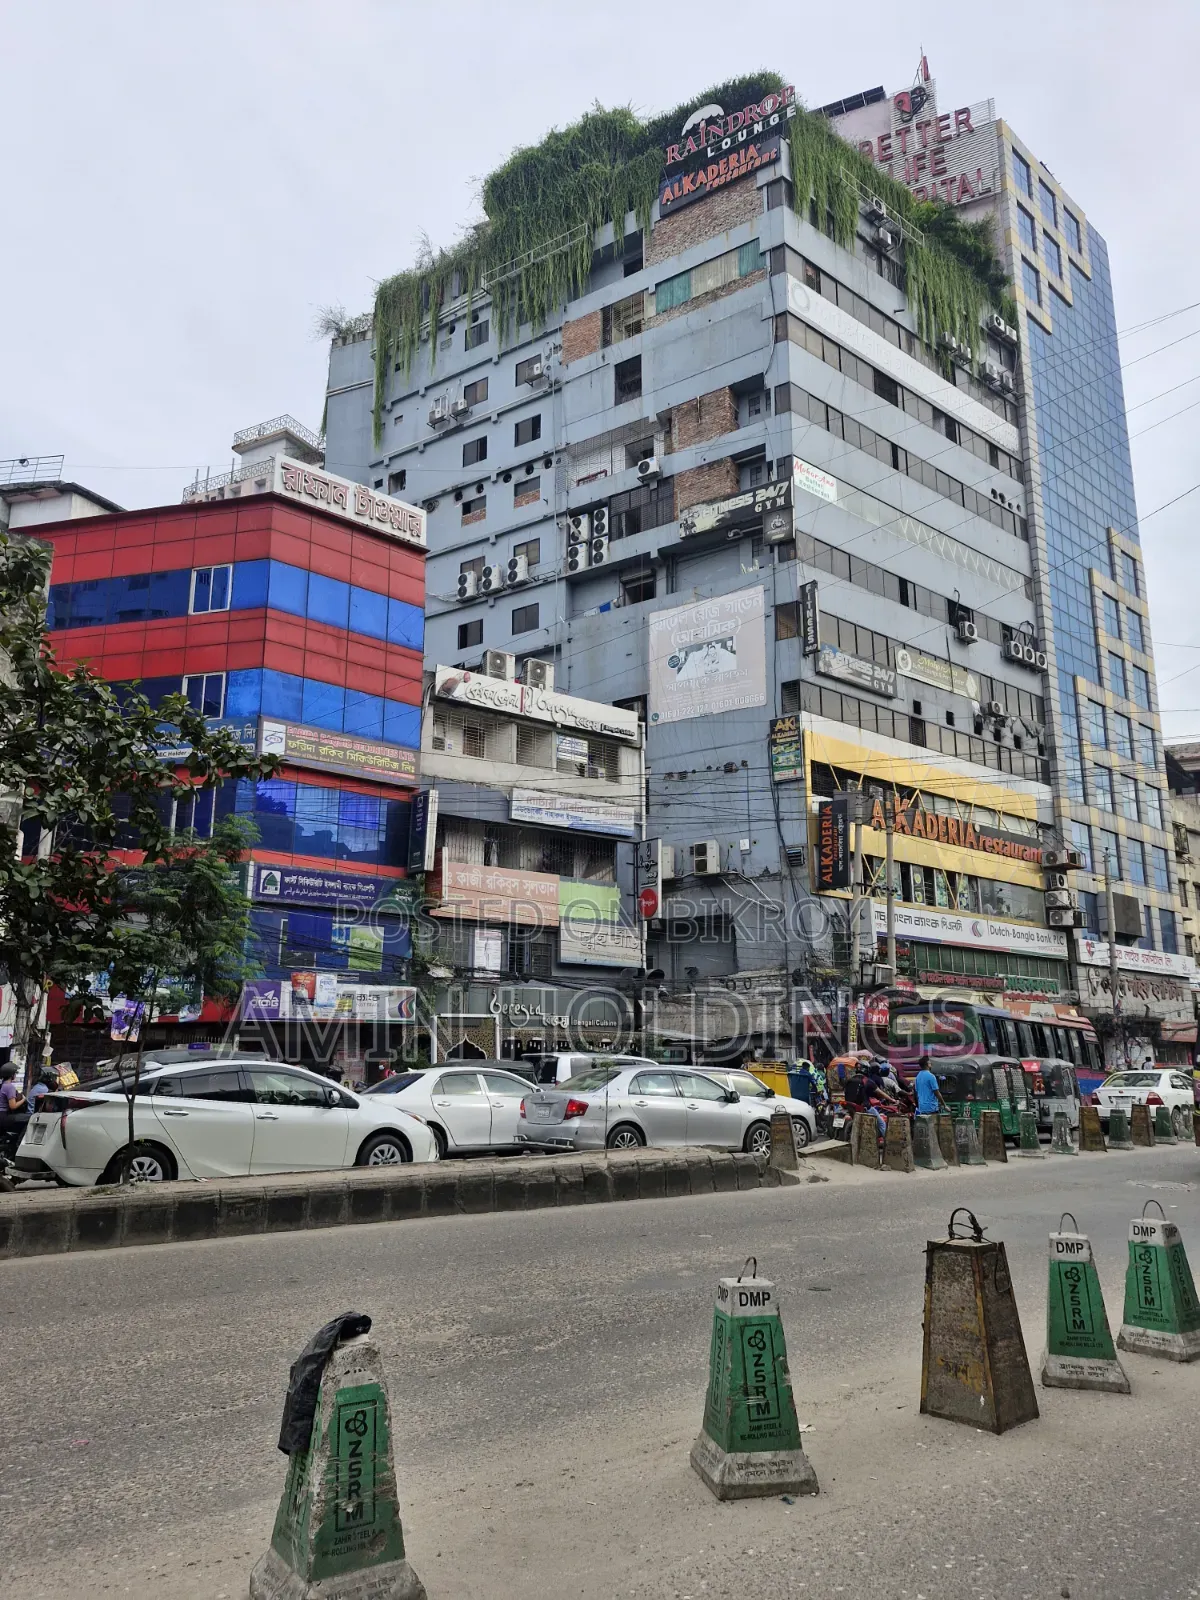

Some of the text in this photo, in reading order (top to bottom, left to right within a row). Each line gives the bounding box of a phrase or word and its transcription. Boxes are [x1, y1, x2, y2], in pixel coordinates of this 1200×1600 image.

[666, 85, 796, 165] RAINDROP
[707, 105, 797, 158] LOUNGE
[662, 144, 758, 204] ALKADERIA
[706, 148, 778, 192] restaurant
[755, 495, 786, 513] GYM
[874, 681, 893, 694] GYM
[287, 739, 315, 753] ফরিদা
[319, 744, 344, 759] রকিব
[346, 748, 399, 770] সিকিউরিটিজ
[821, 804, 833, 883] ALKADERIA
[871, 796, 1043, 863] AKADERIA restaurant
[456, 868, 483, 889] কাজী
[989, 923, 1065, 946] Dutch-Bangla Bank PLC
[868, 1012, 886, 1024] Party
[1056, 1241, 1084, 1254] DMP
[1132, 1224, 1157, 1238] DMP
[1164, 1226, 1178, 1238] DMP
[738, 1291, 771, 1307] DMP
[1142, 1265, 1156, 1307] ZSRM
[1068, 1283, 1086, 1331] ZSRM
[752, 1353, 771, 1416] ZSRM
[345, 1439, 363, 1524] ZSRM
